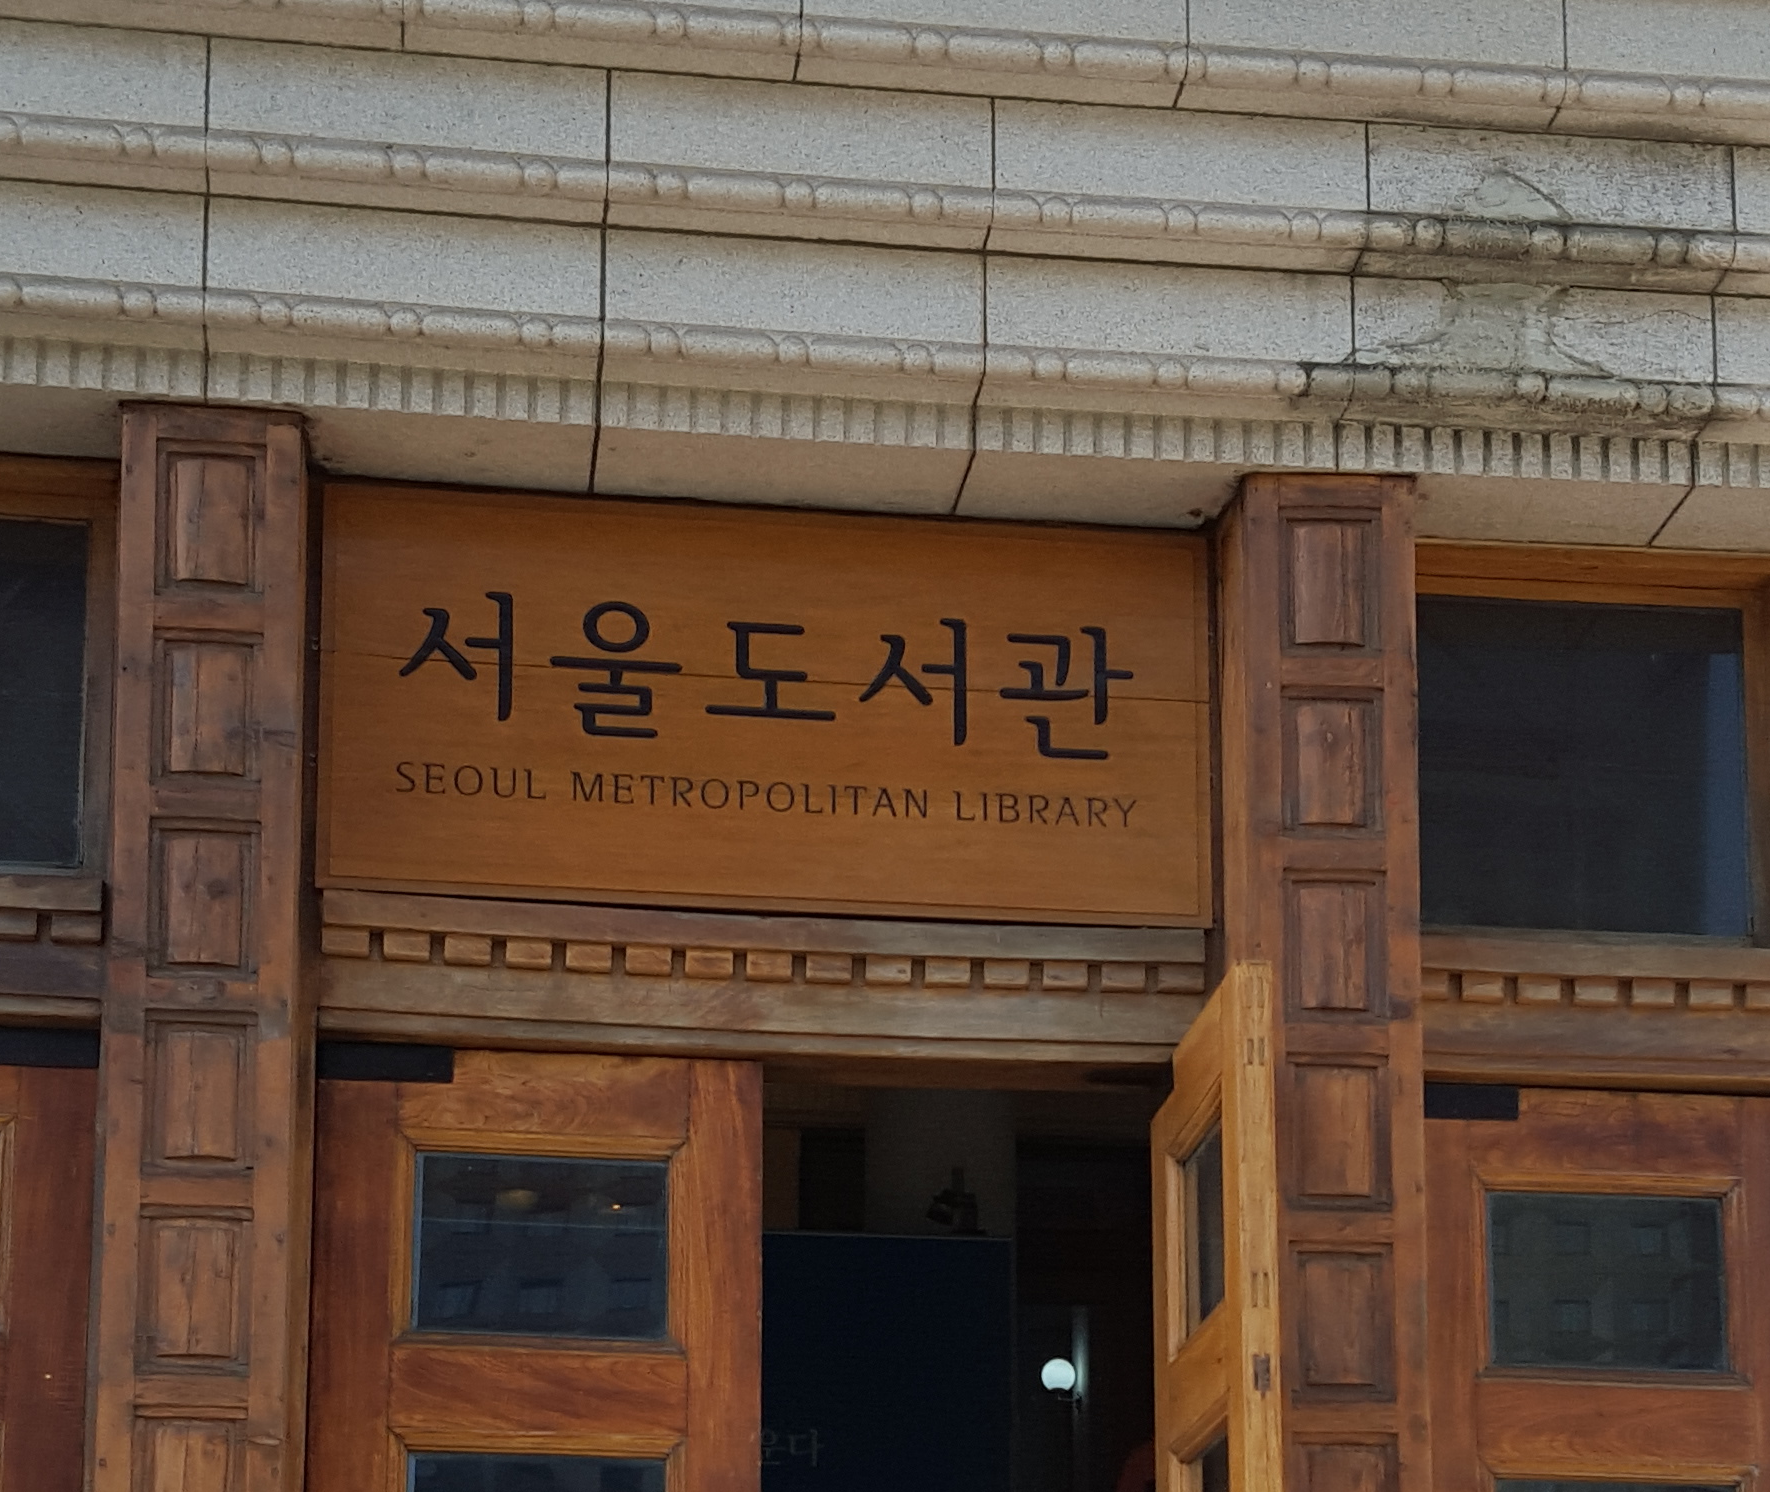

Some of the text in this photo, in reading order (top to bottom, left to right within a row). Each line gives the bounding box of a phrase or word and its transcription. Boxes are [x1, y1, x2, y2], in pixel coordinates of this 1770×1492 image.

[397, 590, 1135, 761] 서울도서관
[395, 761, 1138, 829] SEOUL METROPOLITAN LIBRARY
